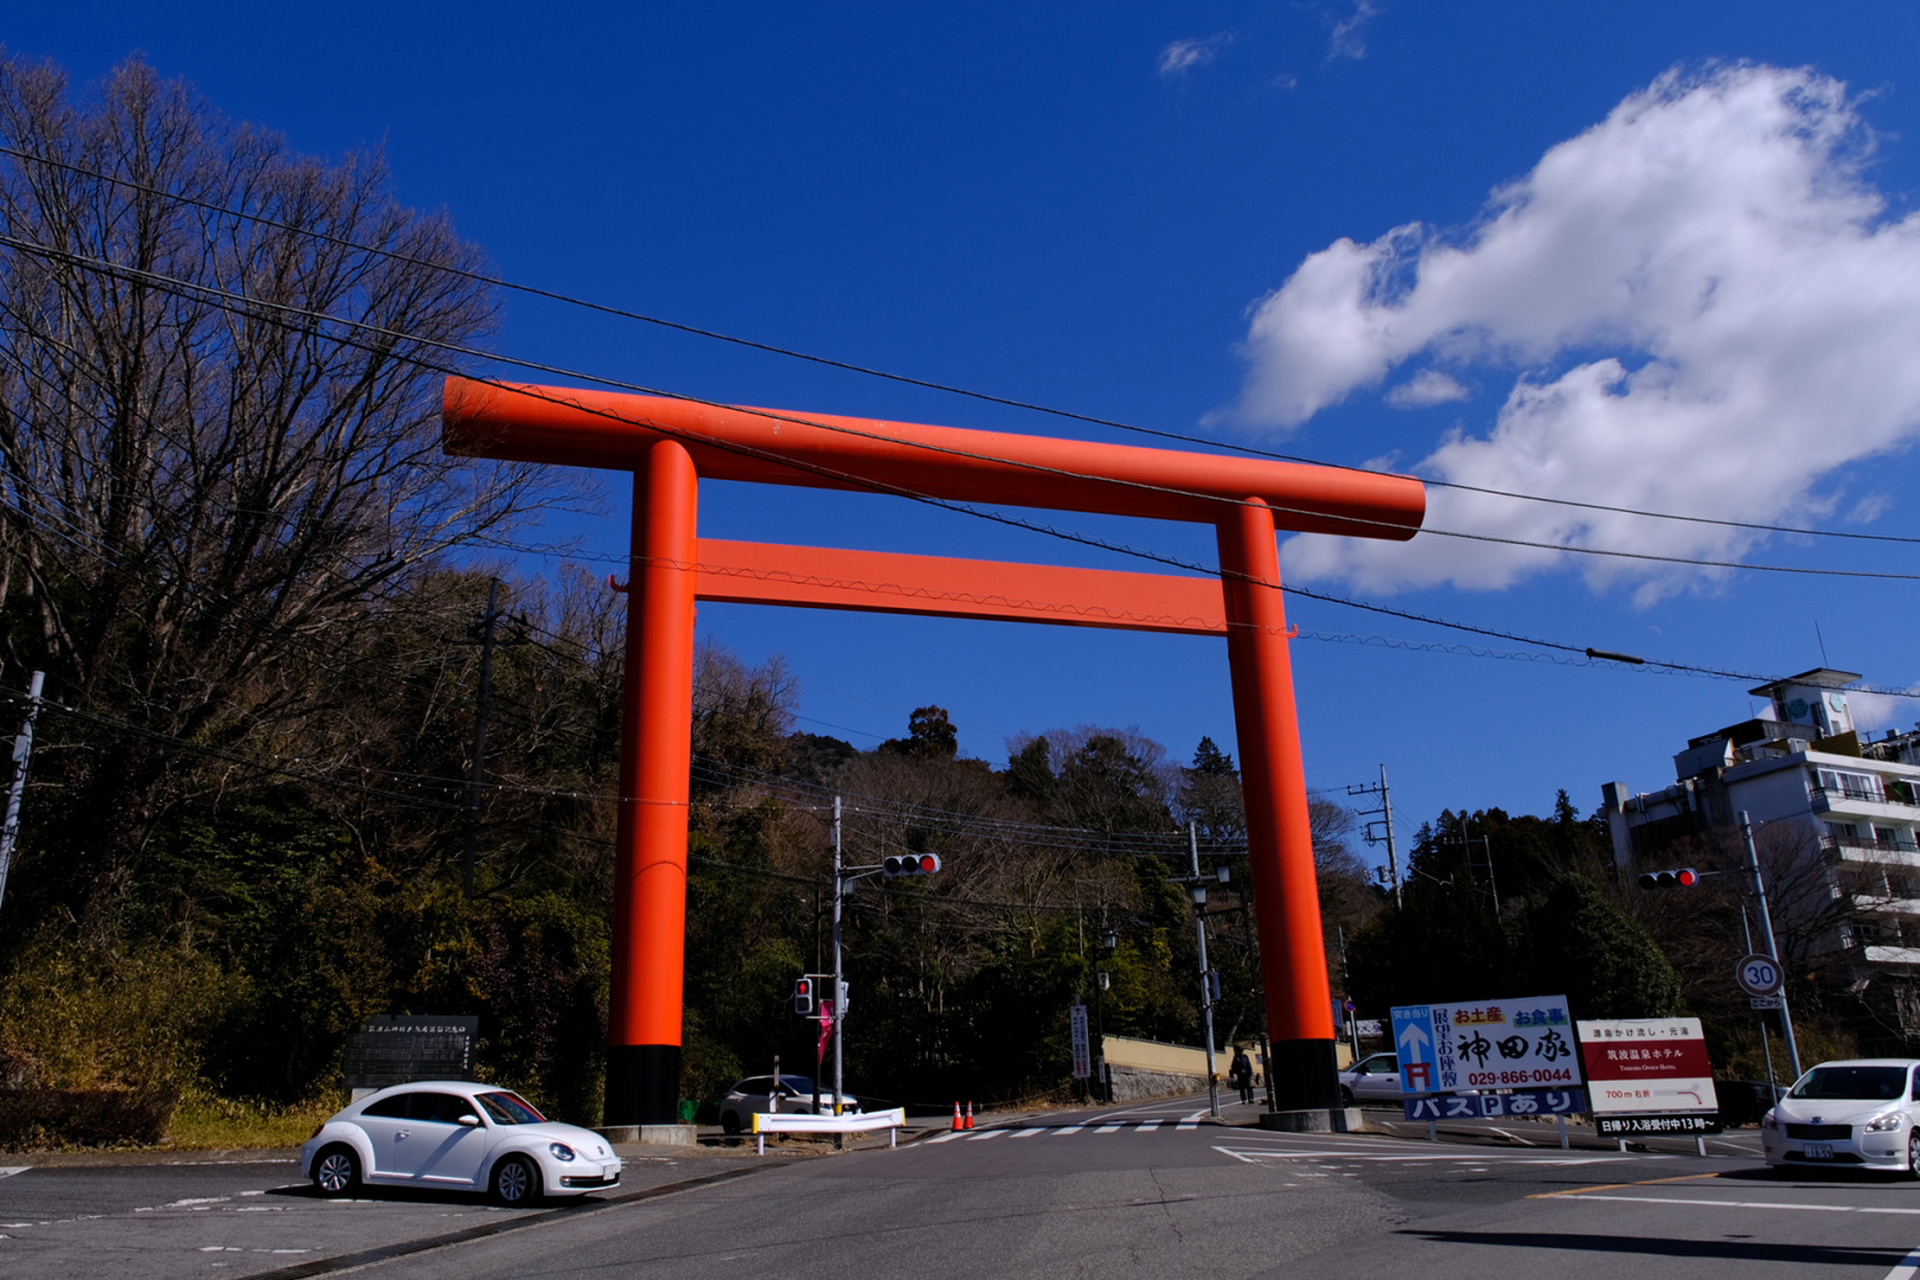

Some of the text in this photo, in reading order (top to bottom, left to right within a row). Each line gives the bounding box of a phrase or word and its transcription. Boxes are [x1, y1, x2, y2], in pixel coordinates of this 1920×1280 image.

[1747, 965, 1773, 985] 30
[1752, 999, 1781, 1007] ここから
[1455, 1006, 1565, 1026] お土産 お食事
[1457, 1027, 1571, 1069] 神田家
[1607, 1049, 1683, 1060] 筑波温泉ホテル
[1468, 1067, 1572, 1086] 029-866-0044
